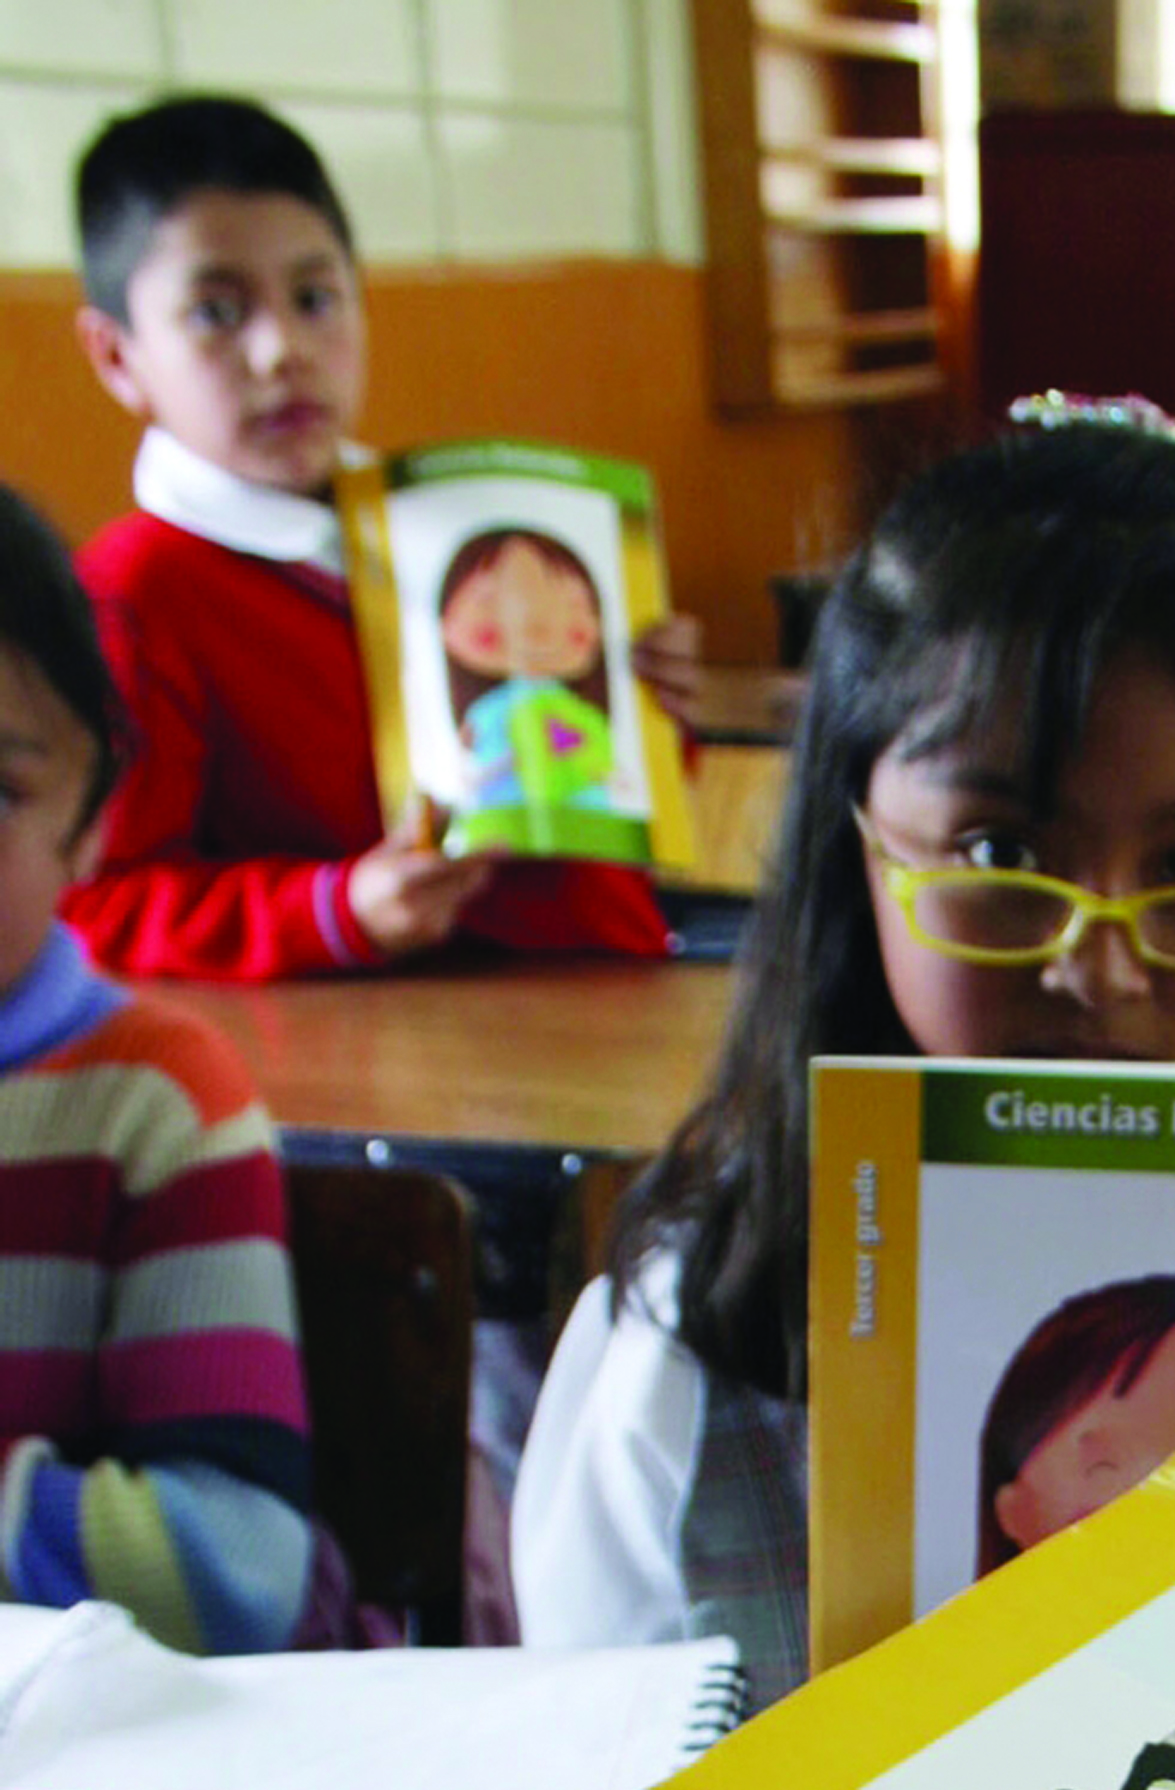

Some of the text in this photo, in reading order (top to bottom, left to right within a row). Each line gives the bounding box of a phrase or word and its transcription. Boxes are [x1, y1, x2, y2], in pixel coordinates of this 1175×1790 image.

[984, 1091, 1159, 1133] Ciencias
[849, 1160, 884, 1338] Tercer grado
